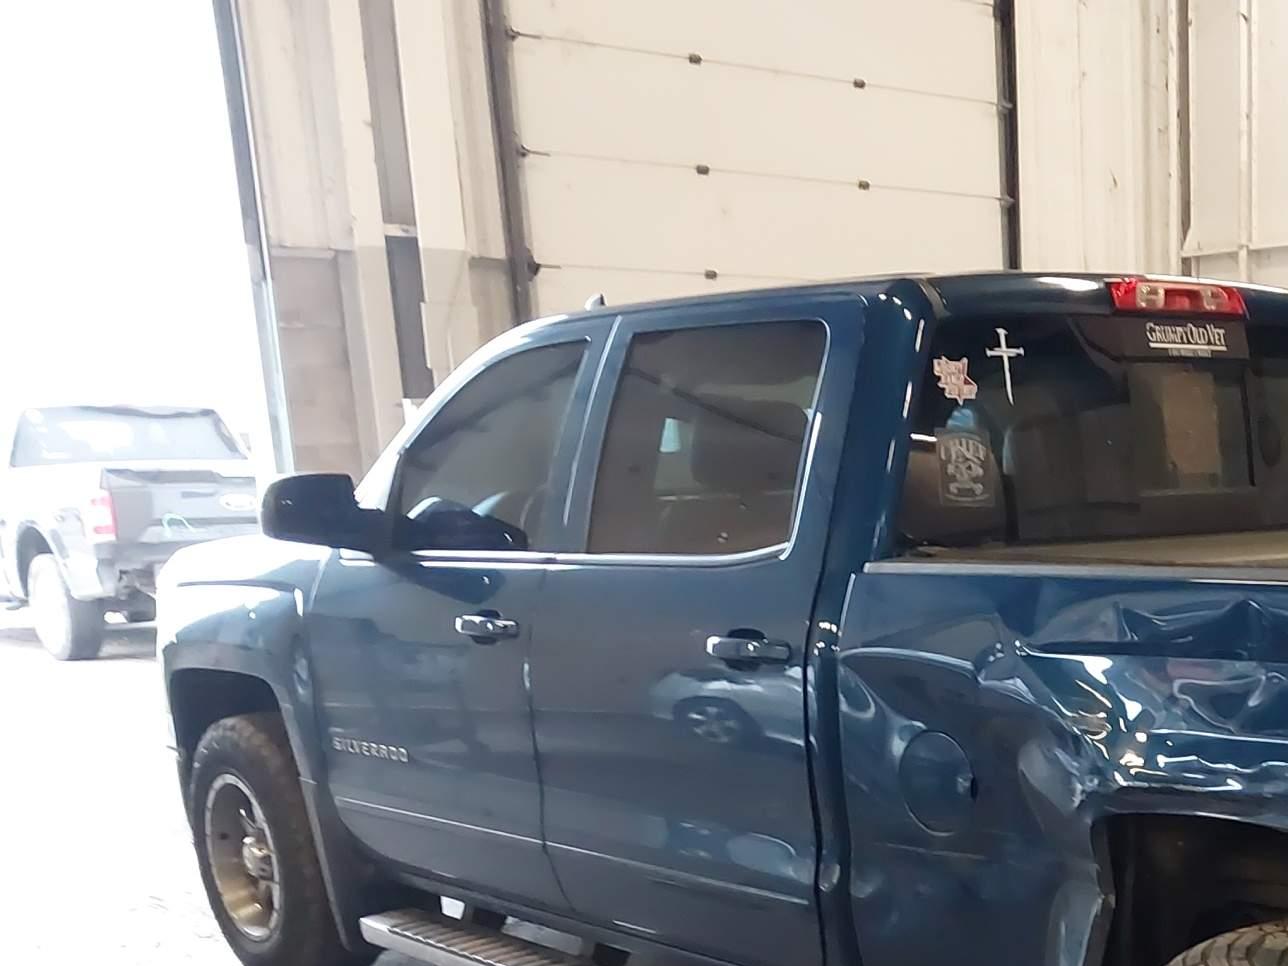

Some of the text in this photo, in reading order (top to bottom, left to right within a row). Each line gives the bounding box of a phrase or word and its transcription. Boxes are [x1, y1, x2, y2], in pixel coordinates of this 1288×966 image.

[1187, 323, 1208, 345] OLD
[1205, 323, 1226, 346] VET
[333, 736, 409, 763] SILVERADO
